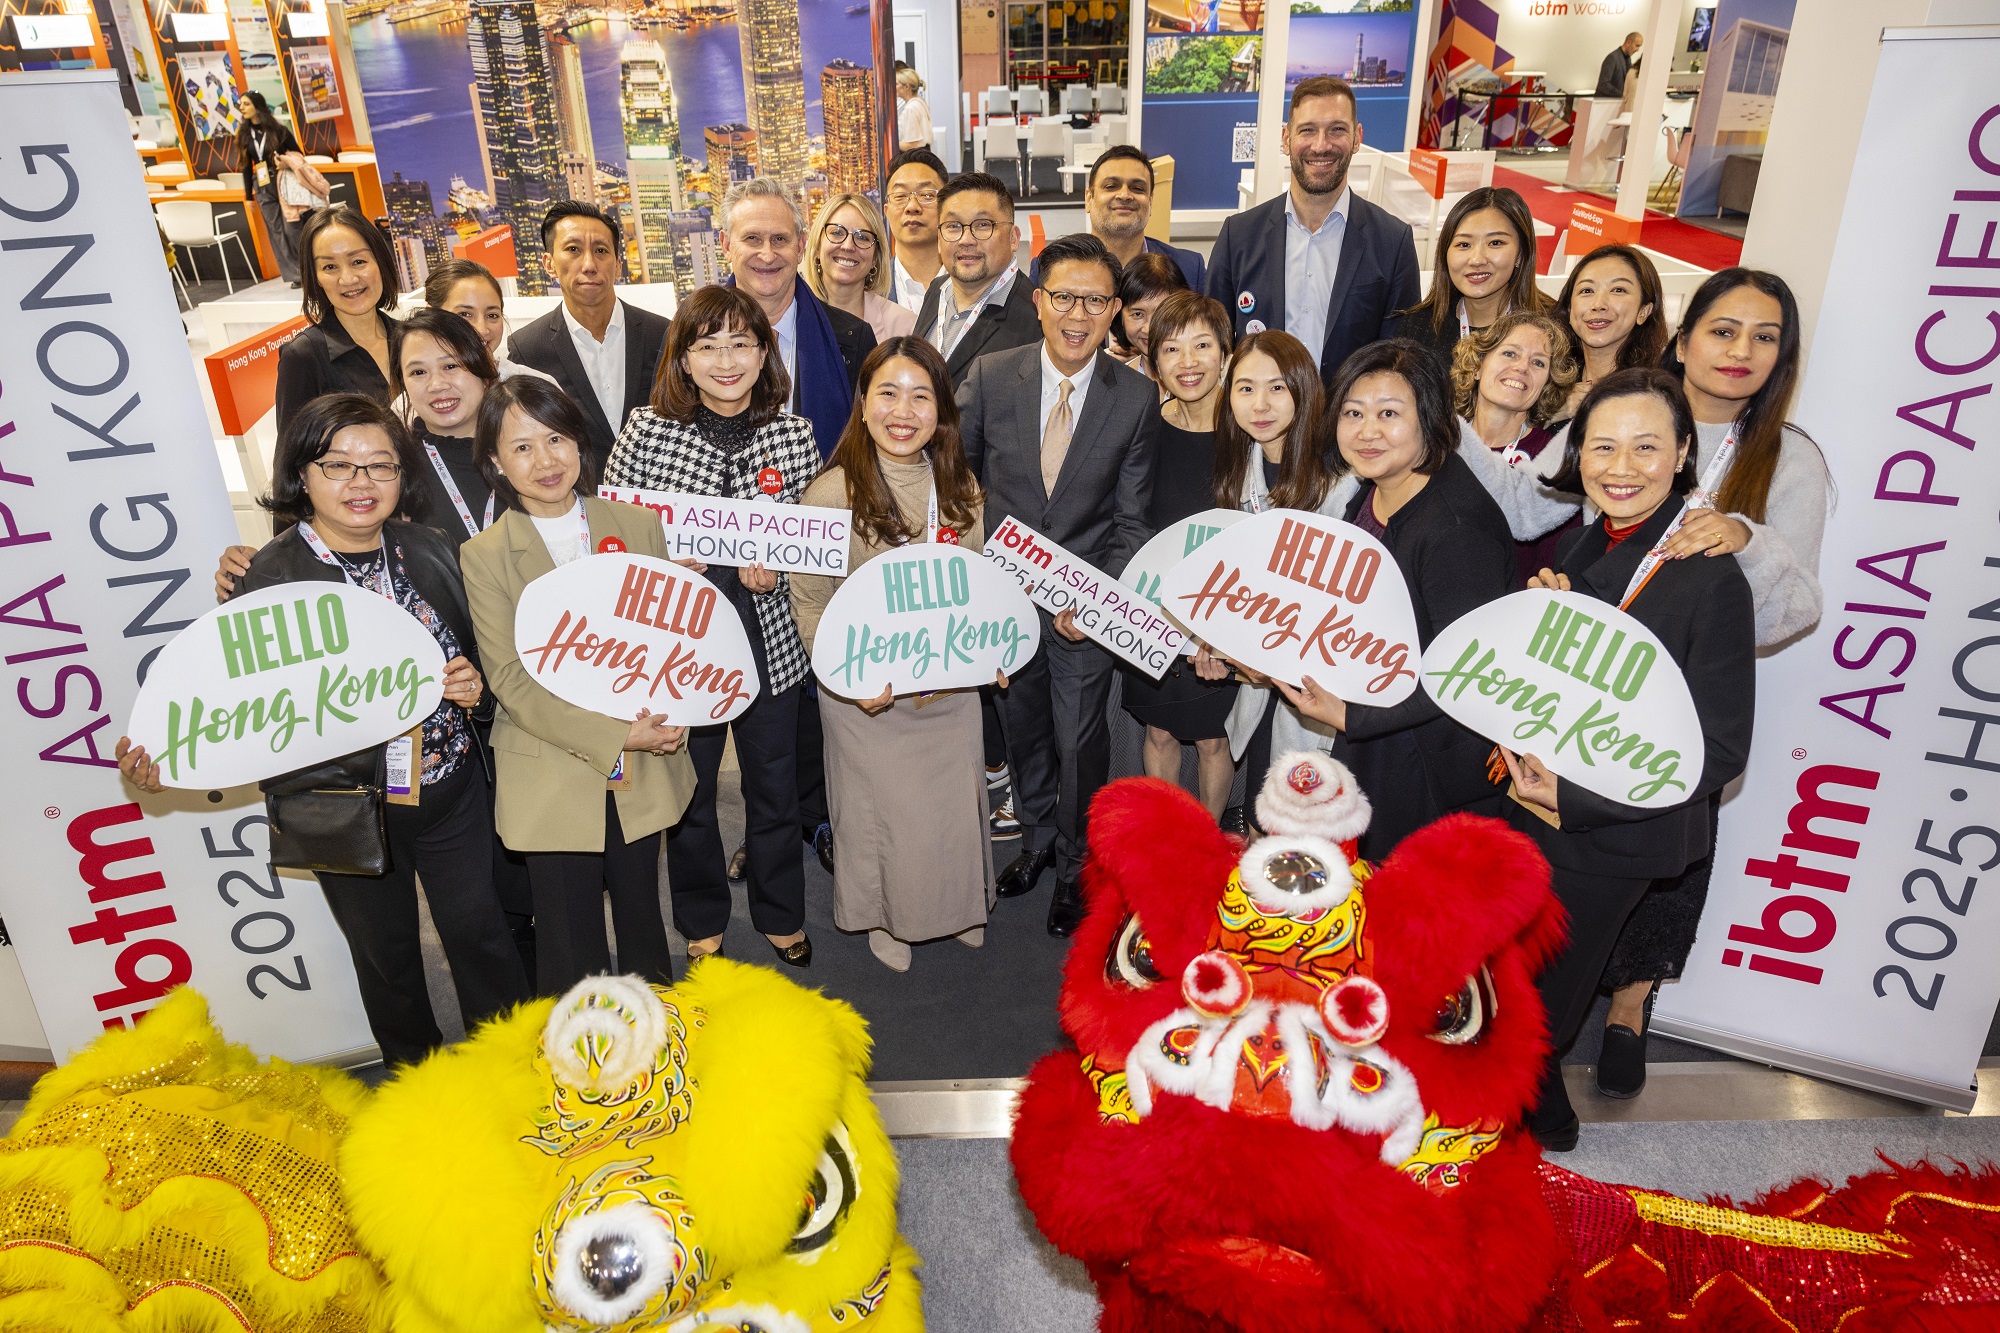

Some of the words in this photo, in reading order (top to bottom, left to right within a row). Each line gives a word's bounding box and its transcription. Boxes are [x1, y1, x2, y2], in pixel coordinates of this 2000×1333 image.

[1529, 0, 1568, 16] ibtm
[1573, 3, 1625, 15] WORLD
[1571, 218, 1595, 234] Management
[1595, 227, 1603, 236] Ltd
[1572, 208, 1603, 224] AsiaWorld-Expo
[0, 145, 156, 462] KONG
[228, 354, 249, 371] Hong
[248, 345, 267, 362] Kong
[266, 335, 292, 352] Tourism
[683, 507, 740, 531] ASIA
[749, 513, 845, 541] PACIFIC
[766, 542, 843, 569] KONG
[1267, 518, 1381, 604] HELLO
[614, 563, 717, 639] HELLO
[884, 556, 969, 614] HELLO
[1052, 563, 1099, 600] ASIA
[1101, 590, 1183, 648] PACIFIC
[1178, 560, 1302, 650] Hong
[1300, 605, 1415, 693] Kong
[0, 574, 121, 769] ASIA
[217, 593, 349, 679] HELLO
[523, 610, 649, 694] Hong
[649, 642, 750, 719] Kong
[829, 623, 939, 688] Hong
[944, 614, 1030, 670] Kong
[1100, 620, 1168, 671] KONG
[1527, 601, 1657, 702] HELLO
[1818, 540, 1947, 740] ASIA
[151, 688, 309, 781] Hong
[316, 648, 434, 736] Kong
[1426, 639, 1560, 740] Hong
[1555, 699, 1686, 802] Kong
[200, 814, 313, 1000] 2025
[1873, 818, 2000, 1011] 2025
